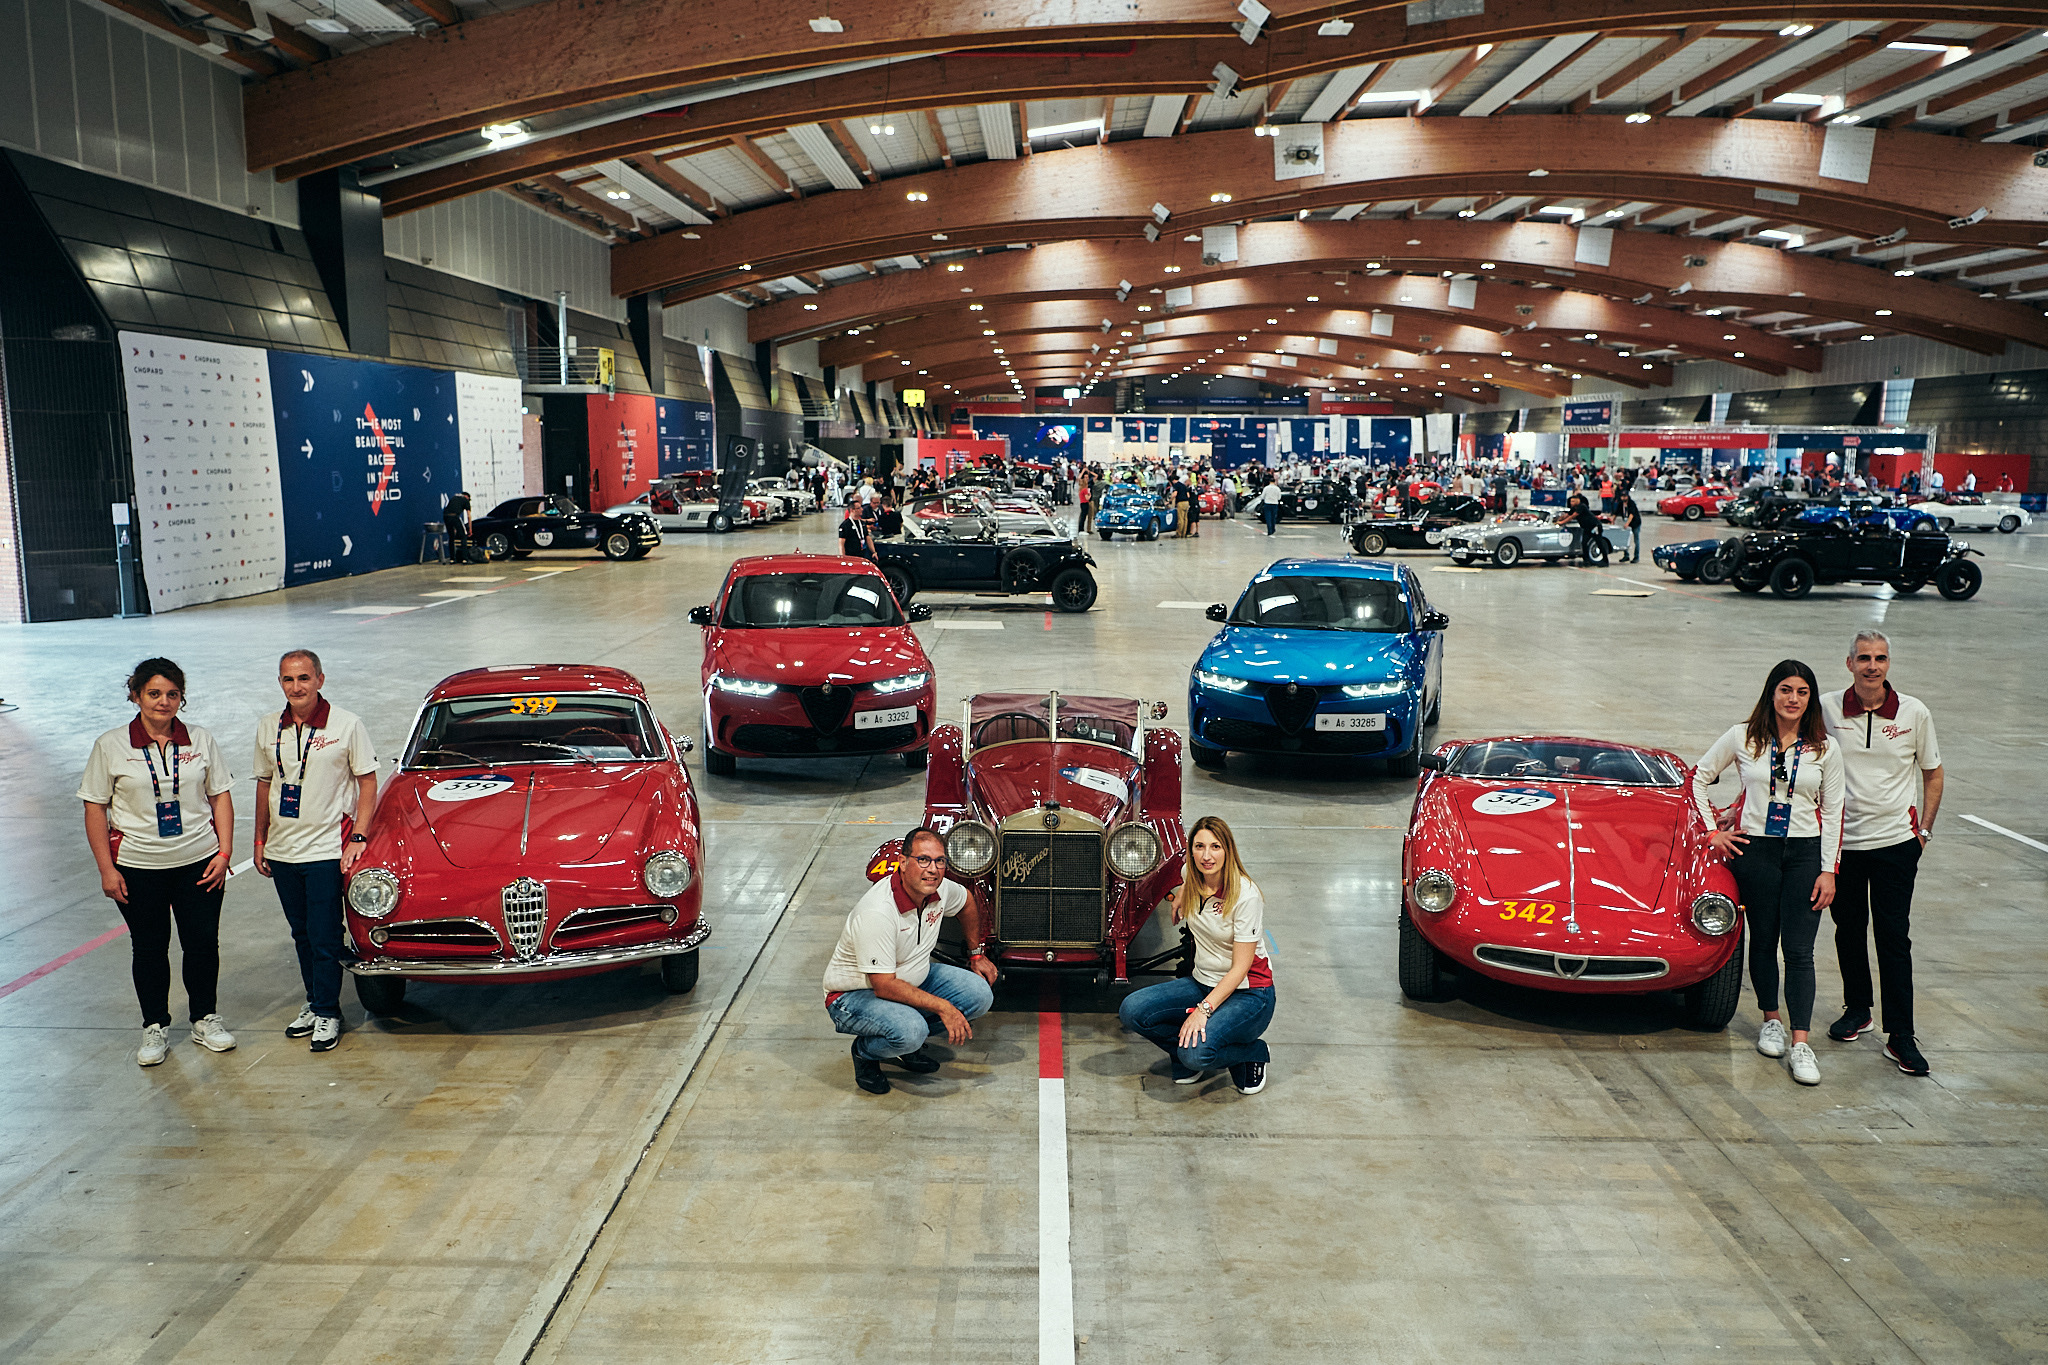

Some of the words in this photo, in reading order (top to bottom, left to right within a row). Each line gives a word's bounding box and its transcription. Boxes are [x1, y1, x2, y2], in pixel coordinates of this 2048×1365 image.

[194, 355, 221, 365] CHOPARD
[134, 366, 163, 375] CHOPARD
[242, 421, 266, 429] CHOPARD
[356, 417, 379, 430] THE
[381, 418, 401, 431] MOST
[355, 435, 405, 448] BEAUTIFUL
[368, 453, 396, 466] RACE
[367, 472, 376, 484] IN
[377, 471, 399, 483] THE
[367, 488, 401, 502] WORLD
[168, 519, 196, 527] CHOPARD
[510, 697, 557, 714] 399
[887, 710, 910, 723] 33292
[1350, 717, 1376, 728] 33285
[444, 782, 499, 791] 399
[1488, 793, 1540, 808] 342
[1002, 850, 1027, 881] Alfa
[1016, 847, 1049, 883] Romeo
[1499, 901, 1556, 925] 342
